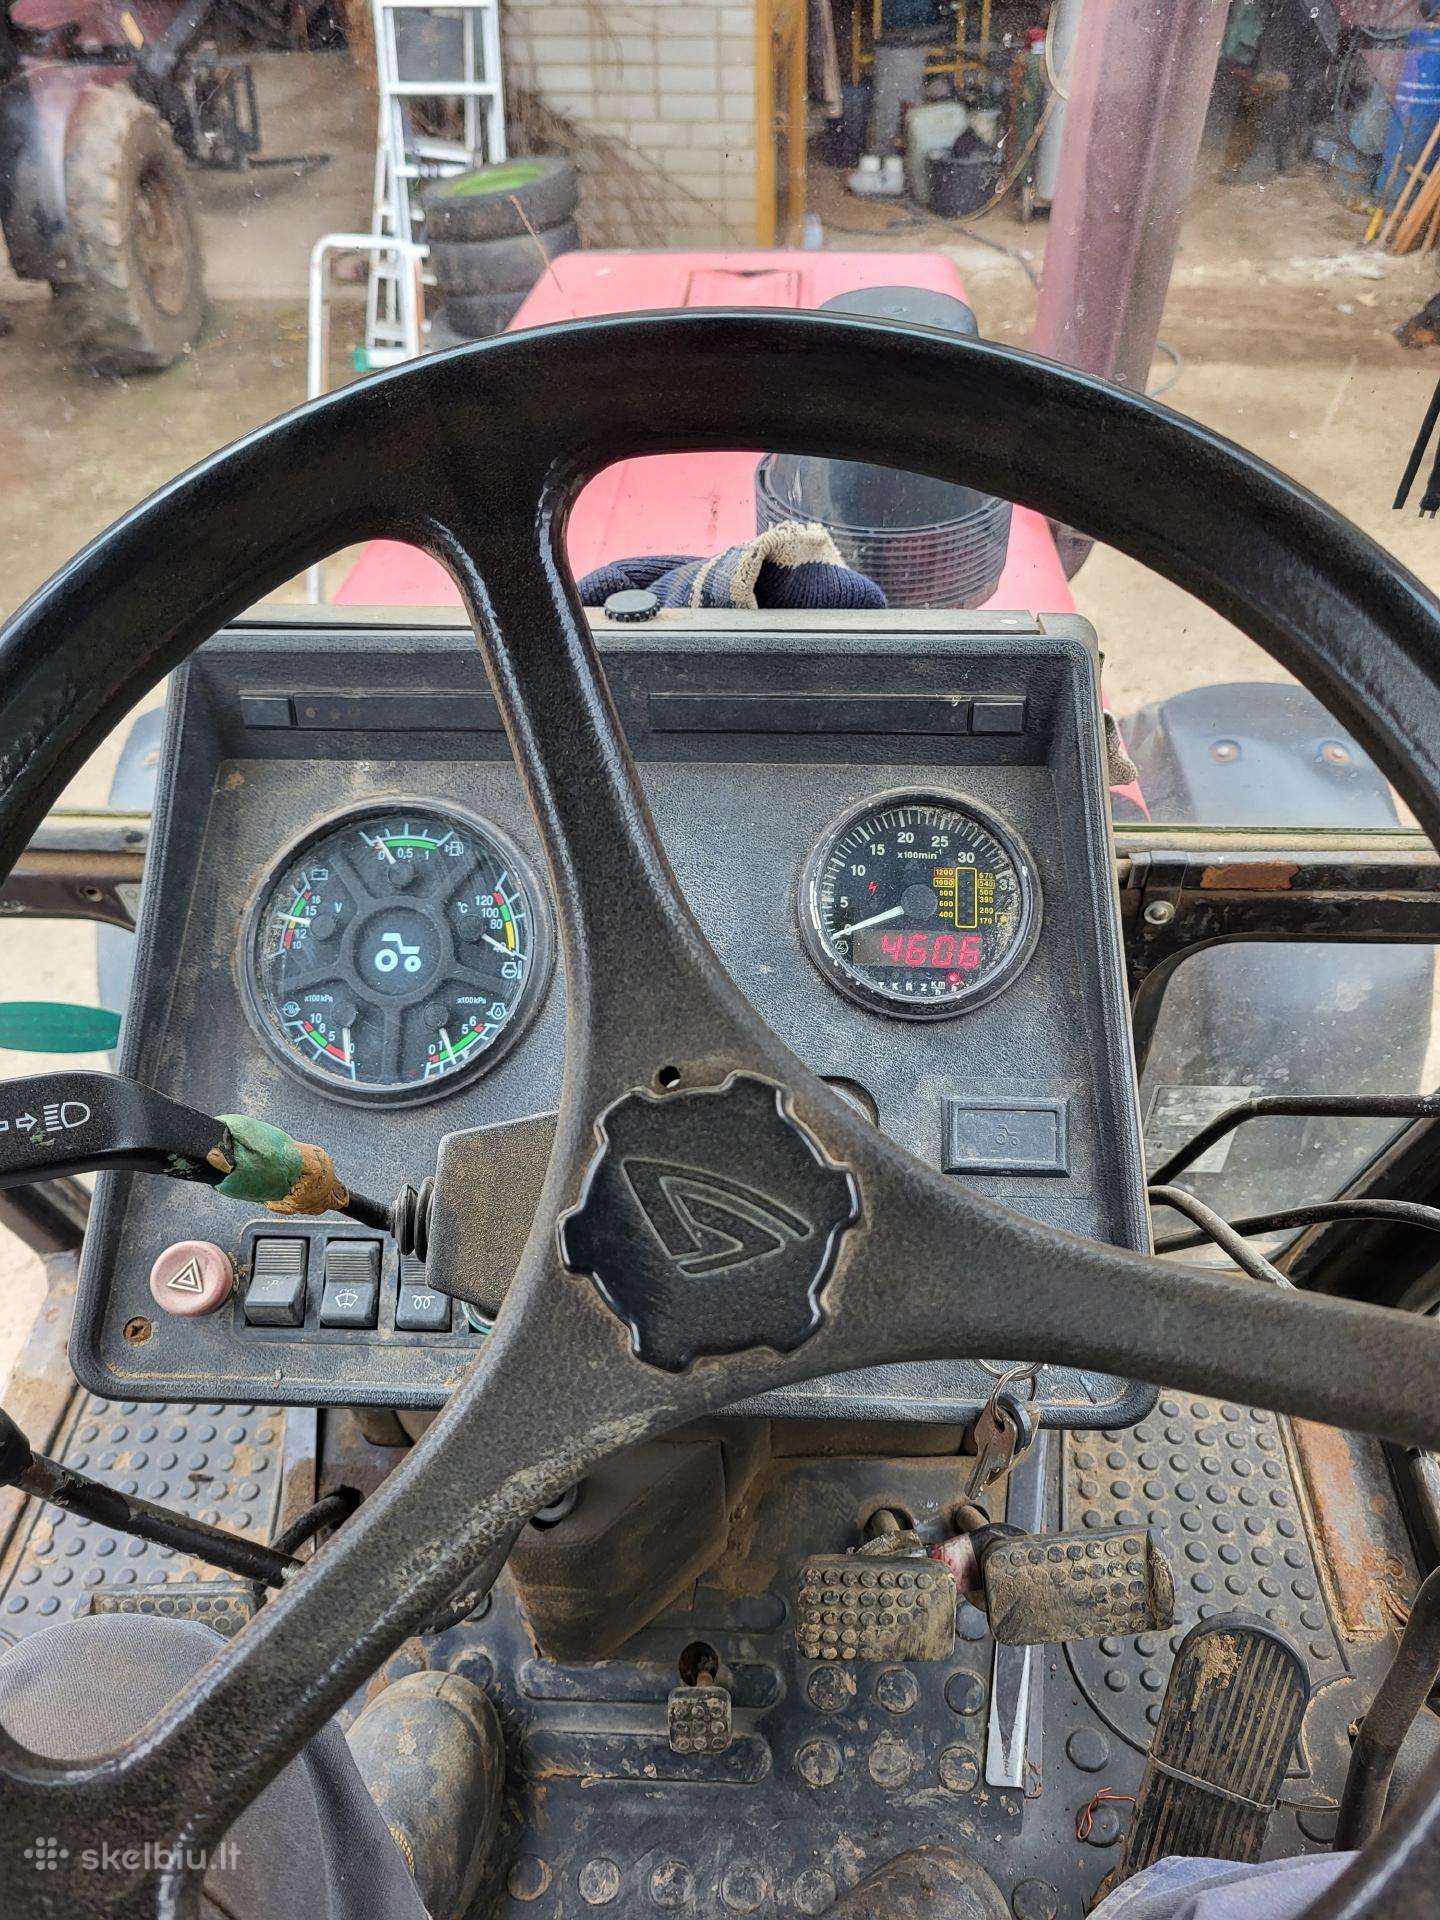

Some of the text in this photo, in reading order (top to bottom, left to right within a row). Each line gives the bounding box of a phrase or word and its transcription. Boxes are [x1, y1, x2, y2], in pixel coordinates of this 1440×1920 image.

[897, 832, 914, 843] 20
[931, 836, 949, 847] 25
[378, 848, 429, 860] 0 0,5 1
[870, 844, 886, 855] 15
[957, 852, 975, 863] 30
[851, 865, 866, 876] 10
[312, 895, 321, 904] 16
[475, 895, 494, 906] 120
[840, 896, 849, 908] 5
[979, 896, 993, 904] 390
[305, 905, 317, 916] 15
[334, 902, 343, 913] V
[481, 907, 500, 918] 100
[979, 907, 993, 915] 280
[490, 919, 503, 929] 80
[980, 917, 992, 925] 170
[881, 932, 982, 970] 4606
[891, 982, 899, 990] K
[920, 983, 928, 992] Z
[310, 1013, 322, 1024] 10
[469, 1016, 477, 1027] 6
[319, 1023, 326, 1034] 8
[461, 1024, 469, 1035] 5
[328, 1031, 336, 1042] 5
[349, 1043, 355, 1054] 0
[428, 1044, 436, 1055] 0
